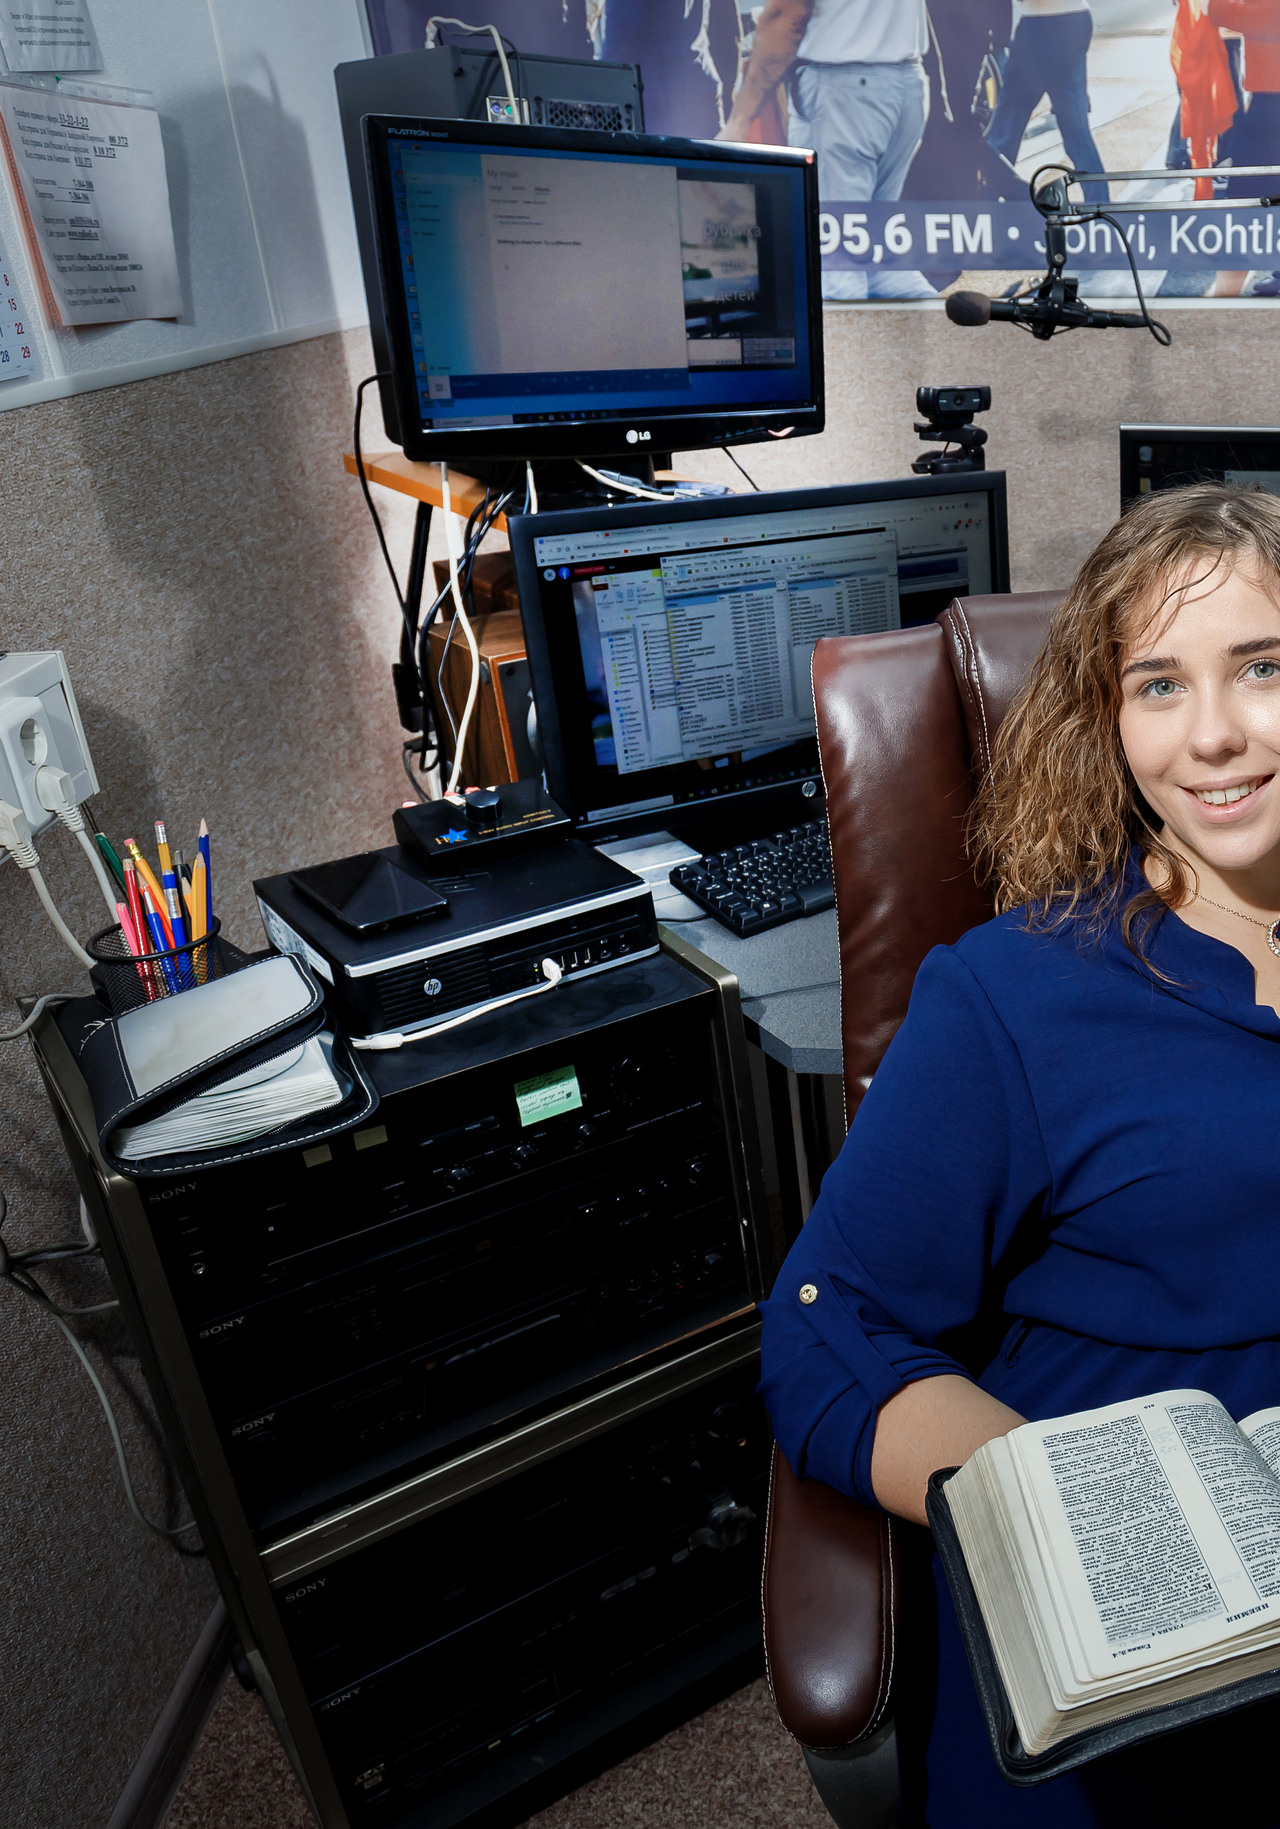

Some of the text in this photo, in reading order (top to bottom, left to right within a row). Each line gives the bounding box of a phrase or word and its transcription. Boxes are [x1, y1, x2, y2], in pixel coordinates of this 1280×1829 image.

[388, 127, 430, 137] FLATRON
[819, 213, 914, 264] 95,6
[924, 213, 993, 254] FM
[7, 298, 18, 310] 15
[14, 322, 25, 335] 22
[21, 345, 31, 359] 29
[149, 1181, 198, 1205] SONY
[199, 1314, 247, 1340] SONY
[231, 1411, 277, 1438] SONY
[285, 1577, 328, 1604] SONY
[1158, 1624, 1184, 1634] ГЛАВА
[1127, 1644, 1151, 1652] Глава
[320, 1686, 362, 1713] SONY
